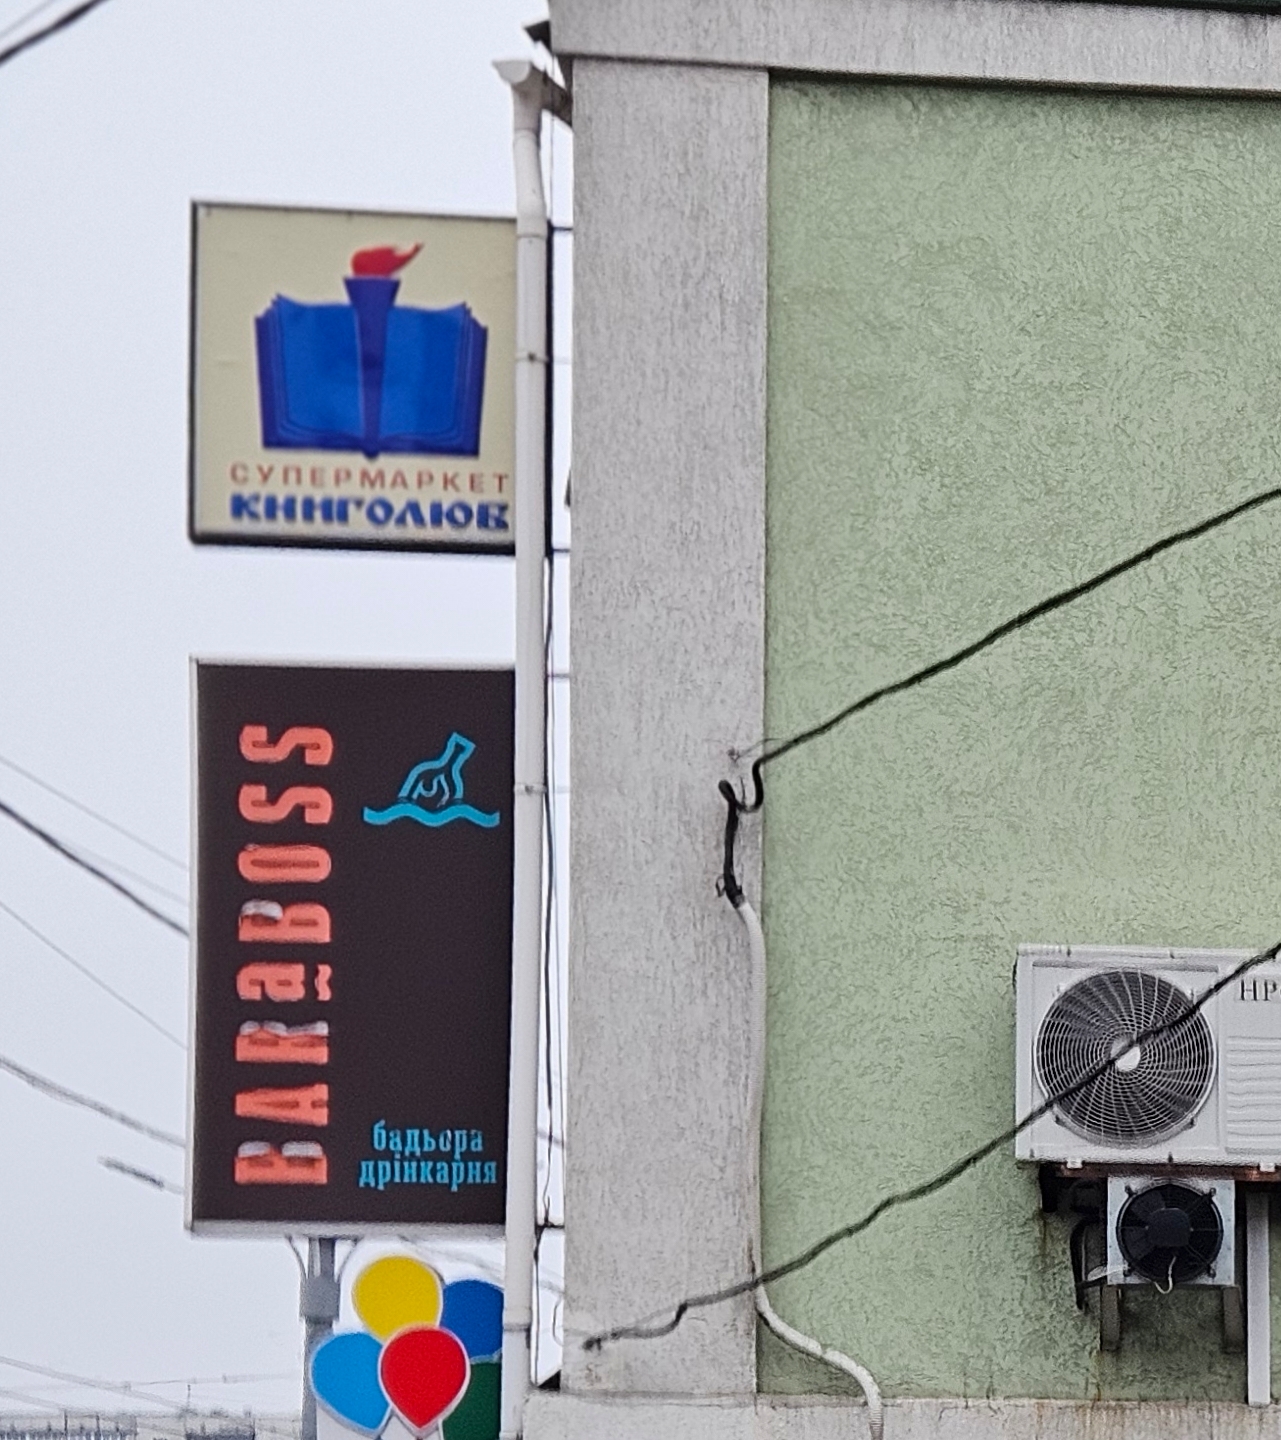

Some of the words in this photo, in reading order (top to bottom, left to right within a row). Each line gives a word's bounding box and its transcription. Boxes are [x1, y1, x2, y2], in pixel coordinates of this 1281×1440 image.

[230, 464, 509, 493] СУПЕРМАРКЕТ
[372, 1119, 484, 1160] бадьора
[358, 1160, 498, 1193] дрінкарня
